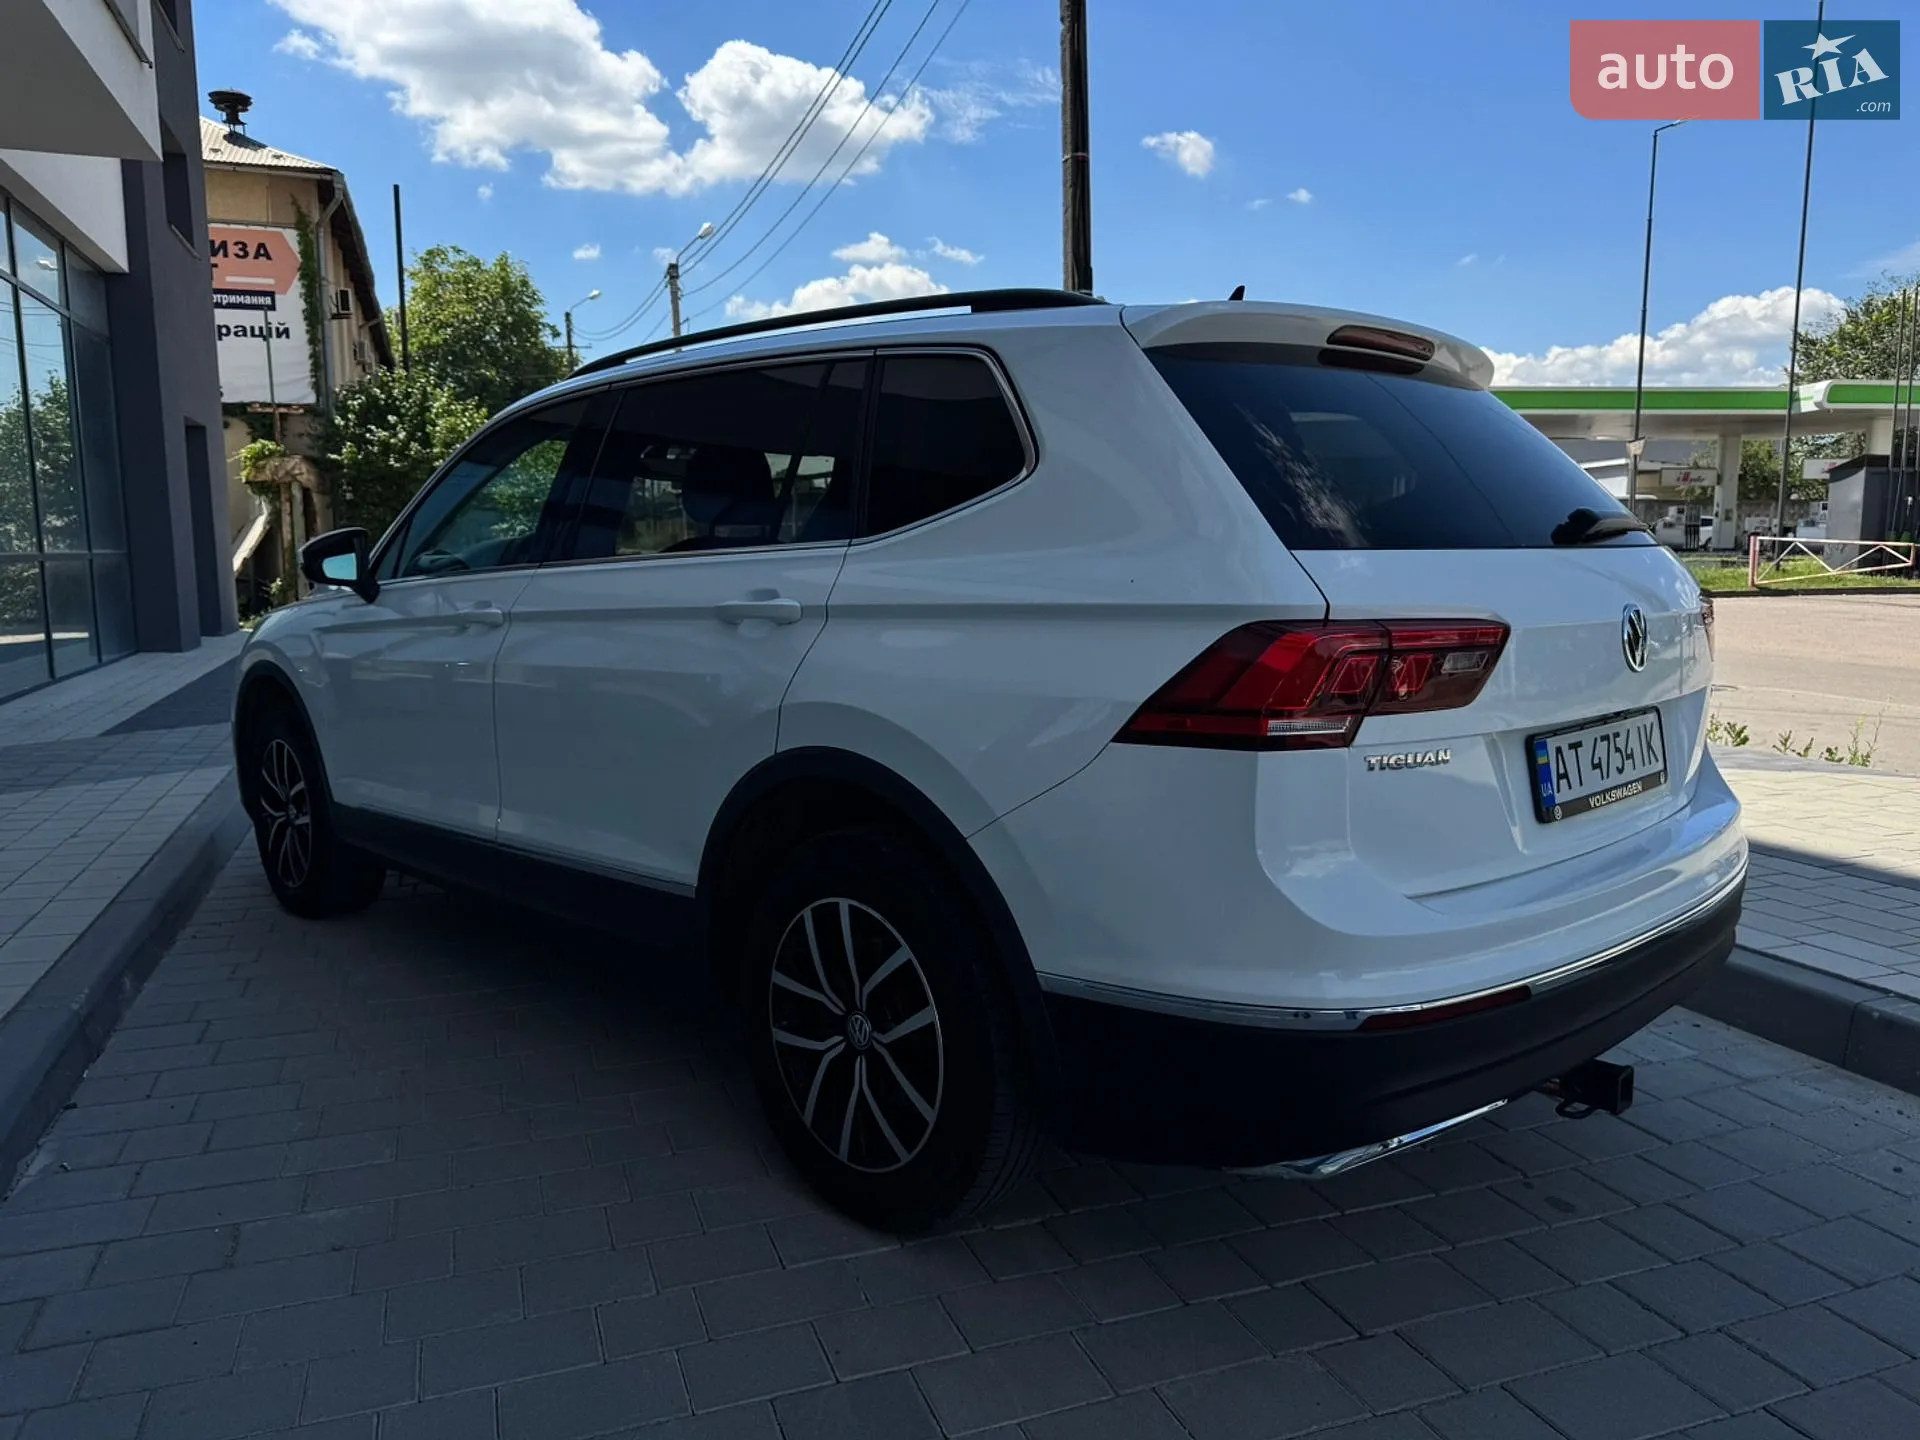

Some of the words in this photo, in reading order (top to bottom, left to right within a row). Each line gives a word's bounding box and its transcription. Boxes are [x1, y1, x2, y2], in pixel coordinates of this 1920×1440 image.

[1364, 747, 1452, 773] TIGUAN
[1554, 740, 1584, 795] AT
[1590, 728, 1636, 782] 4754
[1636, 721, 1660, 768] IK
[1588, 781, 1643, 809] VOLKSWAGEN
